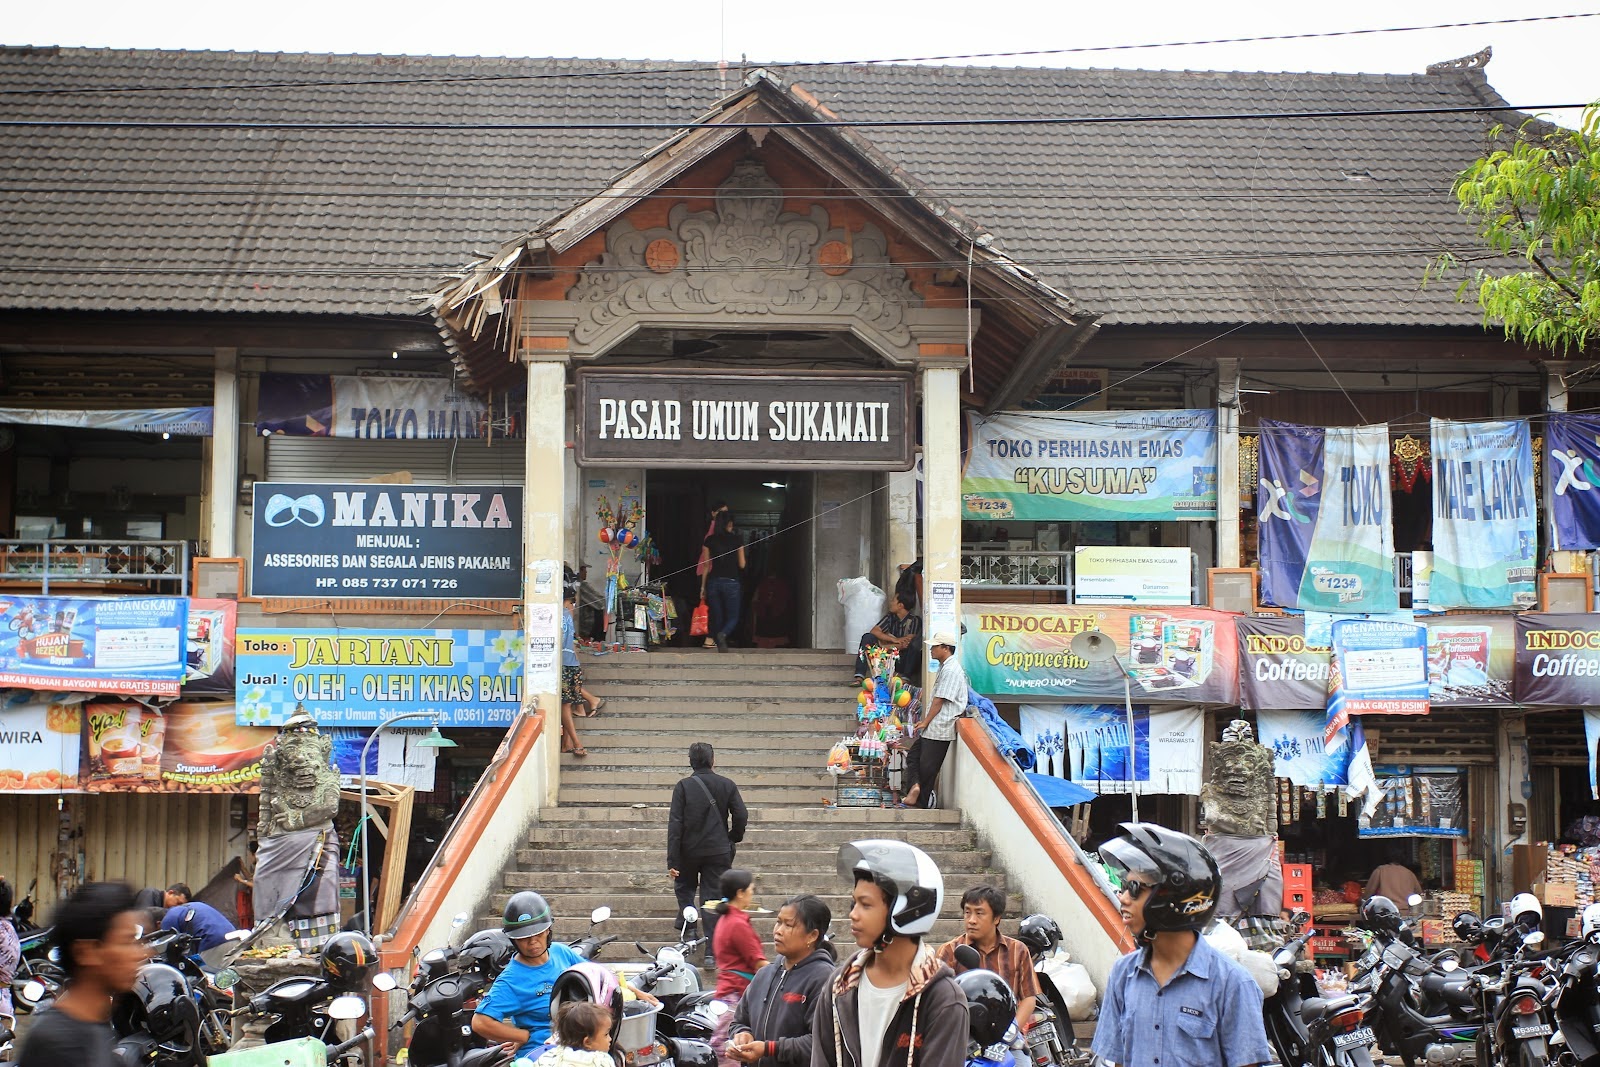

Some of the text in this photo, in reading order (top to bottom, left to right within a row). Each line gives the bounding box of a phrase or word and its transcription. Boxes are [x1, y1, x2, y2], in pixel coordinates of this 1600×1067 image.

[351, 407, 418, 439] TOKO
[599, 398, 890, 443] PASAR UMUM SUKAWATI
[987, 440, 1184, 458] TOKO PERHIASAN EMAS
[1341, 464, 1383, 526] TOKO
[332, 492, 512, 528] MANIKA
[356, 535, 413, 548] MENJUAL
[264, 554, 511, 570] ASSESORIES DAN SEGALA JENIS PAKAIAN
[316, 578, 458, 589] HP. 085 737 071 726
[95, 600, 176, 611] MENANGKAN
[981, 614, 1094, 633] INDOCAFÉ
[1342, 623, 1417, 633] MENANGKAN
[36, 635, 69, 647] HUJAN
[244, 640, 278, 651] Toko
[1248, 636, 1331, 652] INDO
[36, 645, 67, 657] REZEKI
[290, 637, 454, 668] JARIANI
[28, 676, 60, 686] HADIAH
[63, 679, 97, 688] BAYGON
[99, 681, 118, 689] MAX
[120, 682, 150, 690] GRATIS
[242, 674, 277, 685] Jual
[293, 674, 345, 701] OLEH
[362, 674, 414, 701] OLEH
[420, 675, 473, 702] KHAS
[479, 675, 522, 702] BALI
[314, 709, 342, 721] Pasar
[345, 708, 376, 721] Umum
[379, 709, 425, 721] Sukawati
[453, 709, 485, 724] (0361)
[1345, 1030, 1363, 1041] 3126
